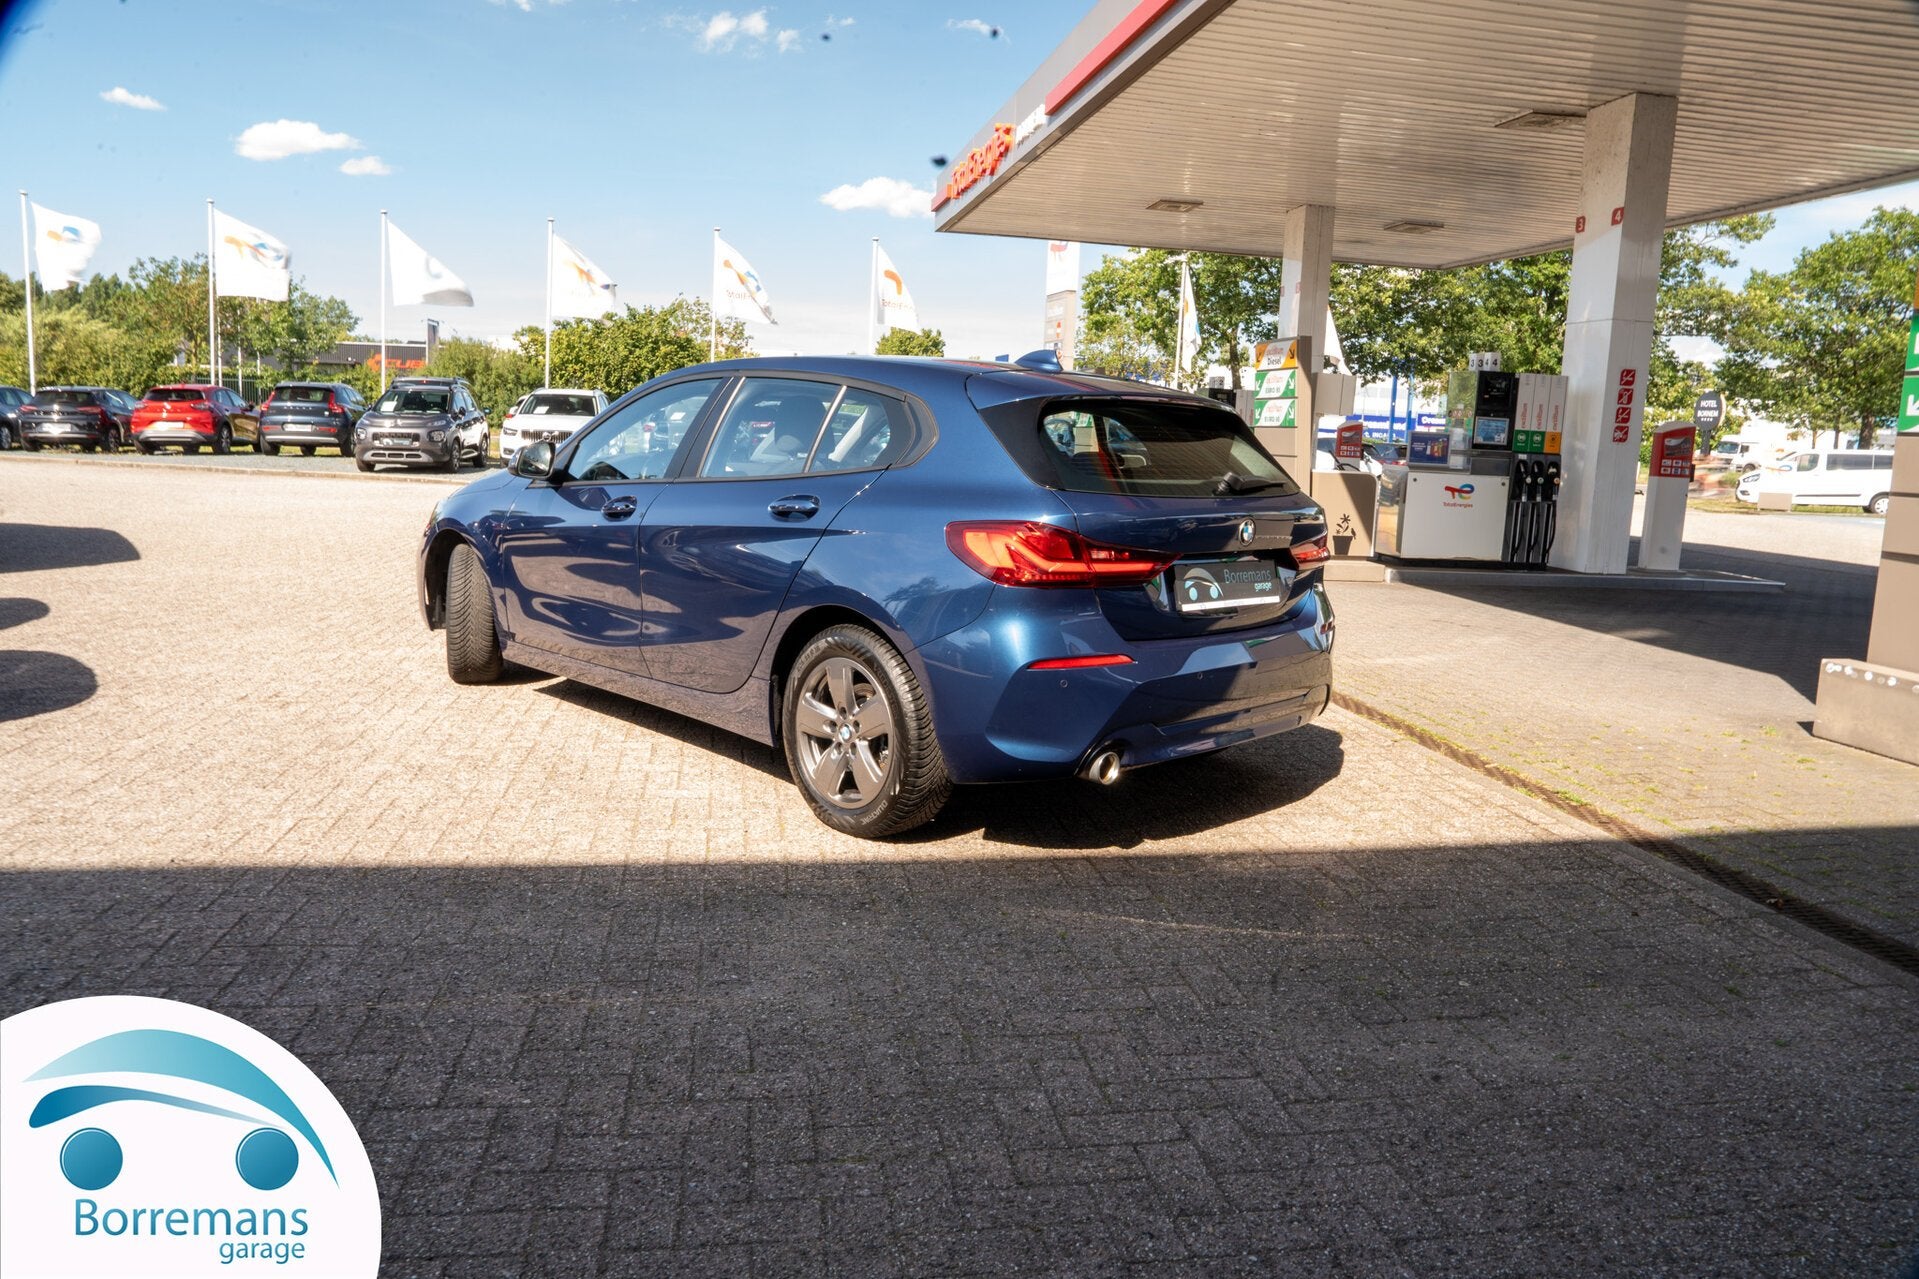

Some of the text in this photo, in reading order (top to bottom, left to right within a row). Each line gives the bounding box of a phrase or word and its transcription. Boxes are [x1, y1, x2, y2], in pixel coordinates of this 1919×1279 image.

[1614, 210, 1622, 223] 4
[1700, 400, 1718, 408] HOTEL
[1224, 569, 1272, 583] Borremans
[1254, 582, 1272, 592] garage
